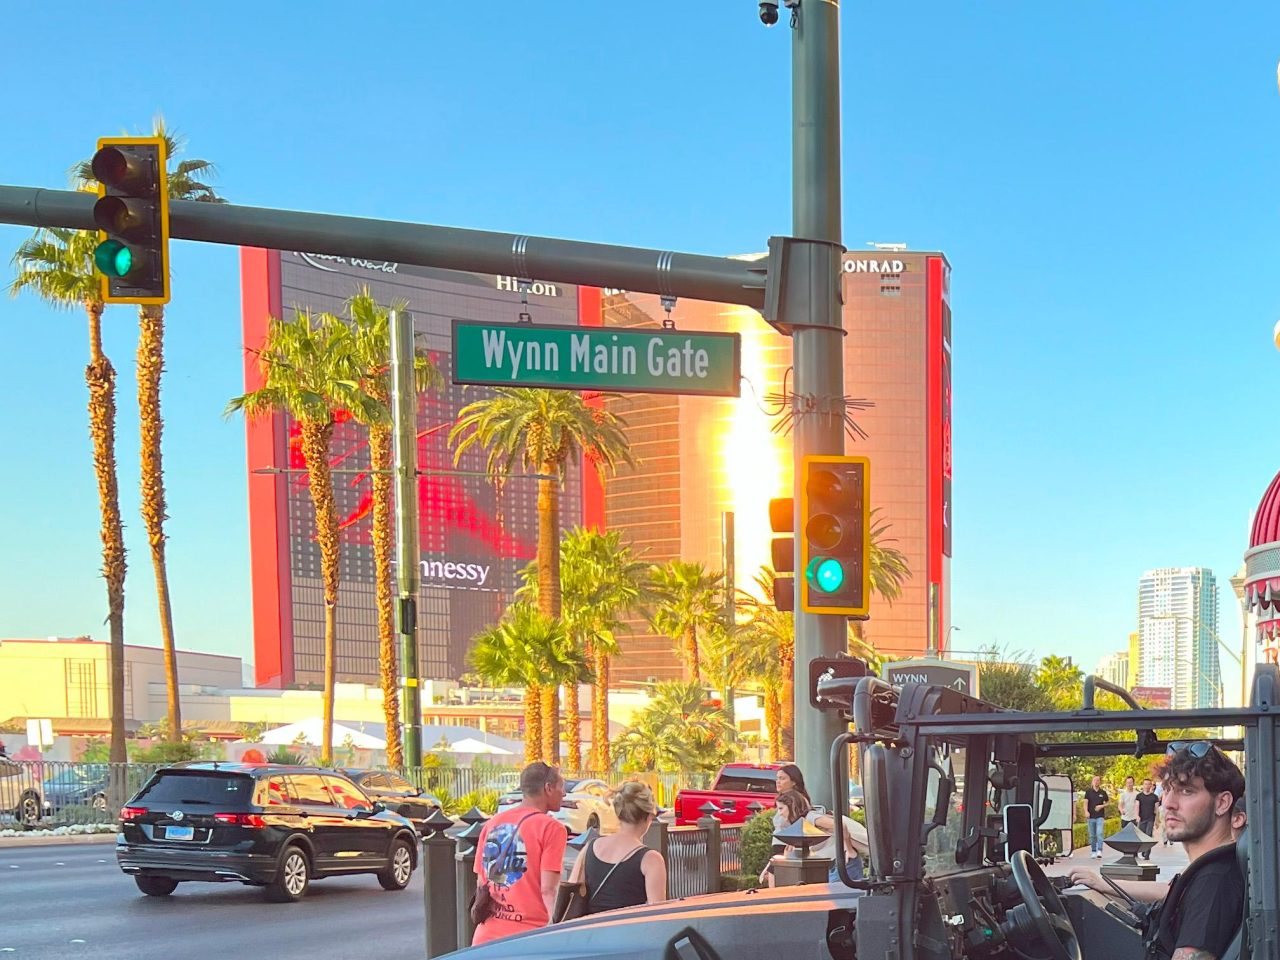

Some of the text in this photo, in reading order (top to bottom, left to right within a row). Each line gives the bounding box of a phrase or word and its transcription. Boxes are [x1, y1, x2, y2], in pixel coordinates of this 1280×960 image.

[843, 260, 905, 273] ONRAD
[496, 275, 557, 297] Hion
[482, 329, 709, 380] Wynn Main Gate
[892, 673, 928, 684] WYNN
